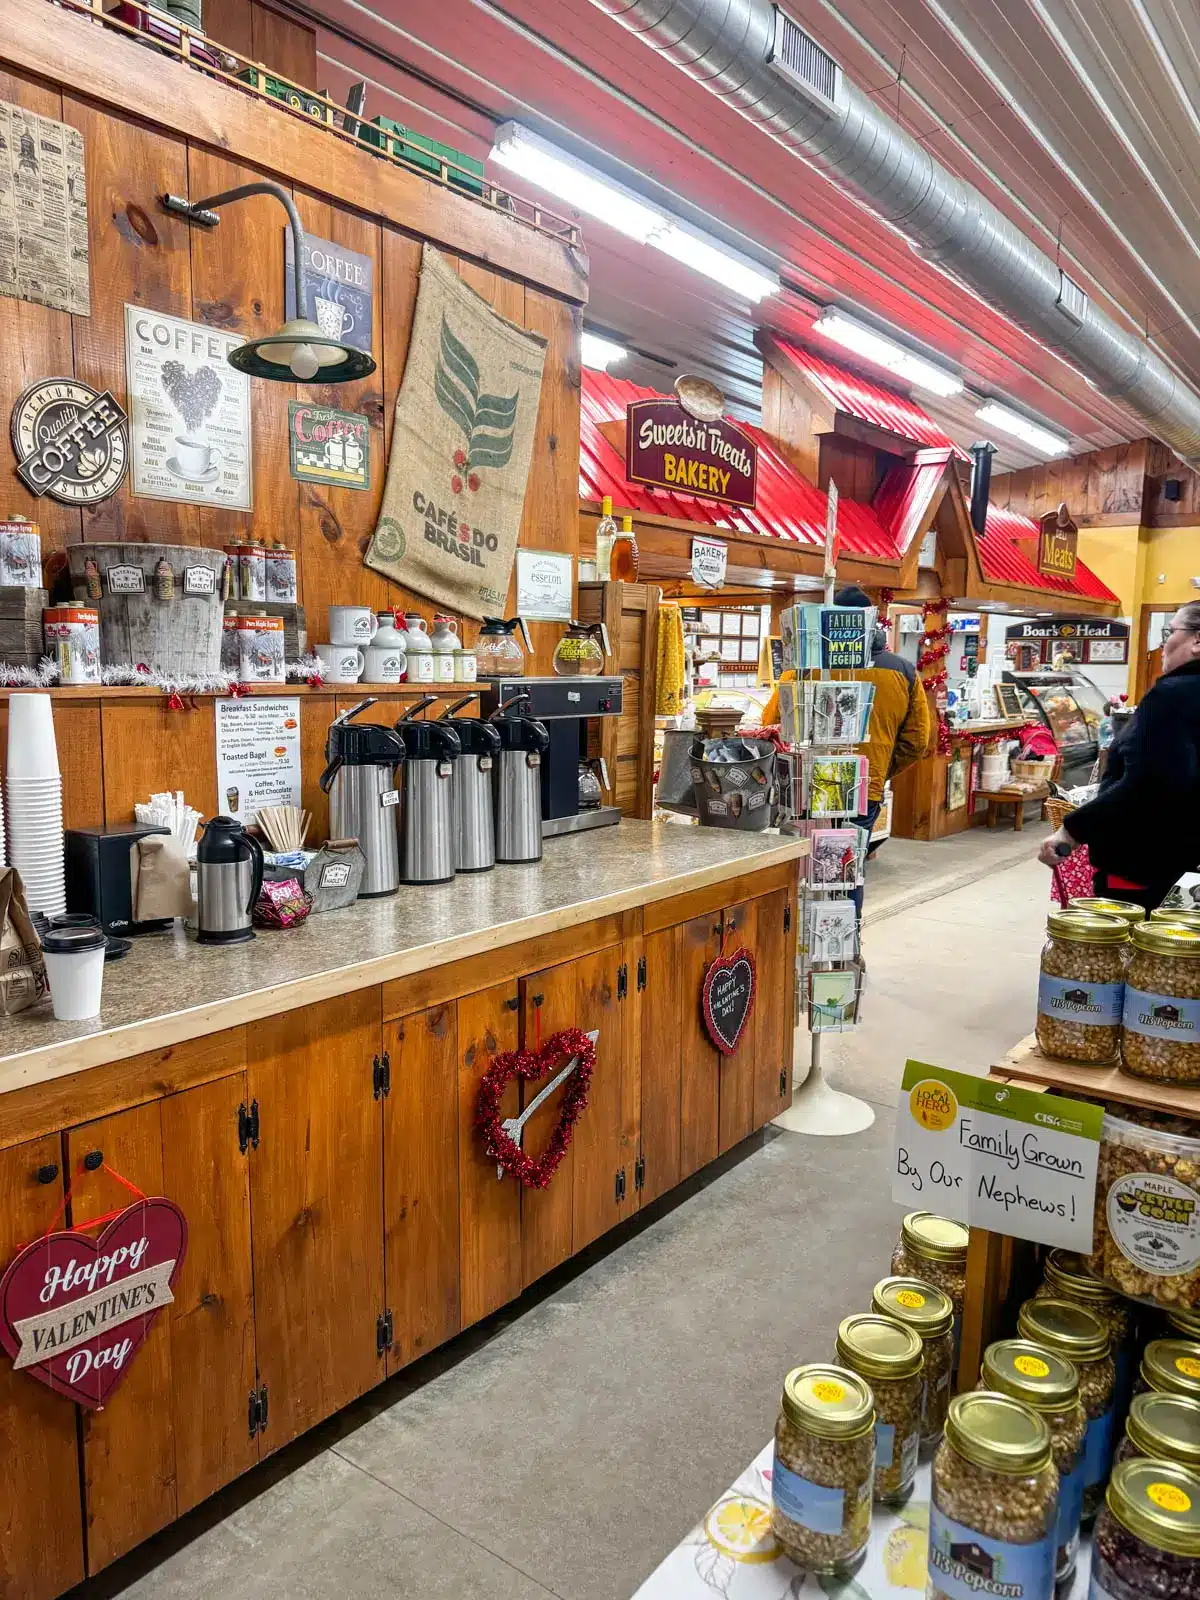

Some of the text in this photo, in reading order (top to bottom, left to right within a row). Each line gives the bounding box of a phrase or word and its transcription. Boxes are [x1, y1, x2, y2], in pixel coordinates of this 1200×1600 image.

[22, 386, 75, 433] PREMIUM
[39, 405, 80, 443] Quality
[294, 408, 365, 444] Coffee
[29, 400, 119, 484] COFFEE
[61, 434, 123, 497] SINCE 1875
[663, 453, 732, 495] BAKERY
[424, 521, 487, 569] BRASIL
[472, 528, 499, 552] DO
[694, 546, 726, 563] BAKERY
[1043, 533, 1074, 570] Meats
[828, 614, 863, 628] FATHER
[1022, 623, 1111, 637] Boar's Head
[828, 630, 861, 639] man
[828, 641, 863, 652] MYTH
[828, 654, 862, 665] LEGEND
[221, 703, 289, 713] Breakfast Sandwiches
[222, 751, 267, 761] Toasted Bagel
[255, 780, 275, 788] Coffee,
[265, 786, 293, 795] Chocolate
[717, 976, 737, 997] HAPPY
[721, 1000, 735, 1017] DAY!
[1066, 1000, 1102, 1013] Popcorn
[1154, 1016, 1194, 1029] Popcorn
[916, 1097, 951, 1114] HERO
[917, 1089, 950, 1105] LOCAL
[959, 1119, 1082, 1174] Family Grown
[896, 1148, 923, 1191] By
[929, 1160, 963, 1189] Our
[977, 1175, 1077, 1223] Nephews!
[1143, 1181, 1175, 1195] MAPLE
[1134, 1188, 1195, 1213] KETTLE
[1139, 1203, 1190, 1226] CORN
[40, 1236, 150, 1303] Happy
[31, 1281, 157, 1353] VALENTINE'S
[66, 1337, 133, 1384] Day
[951, 1563, 1024, 1598] Popcorn
